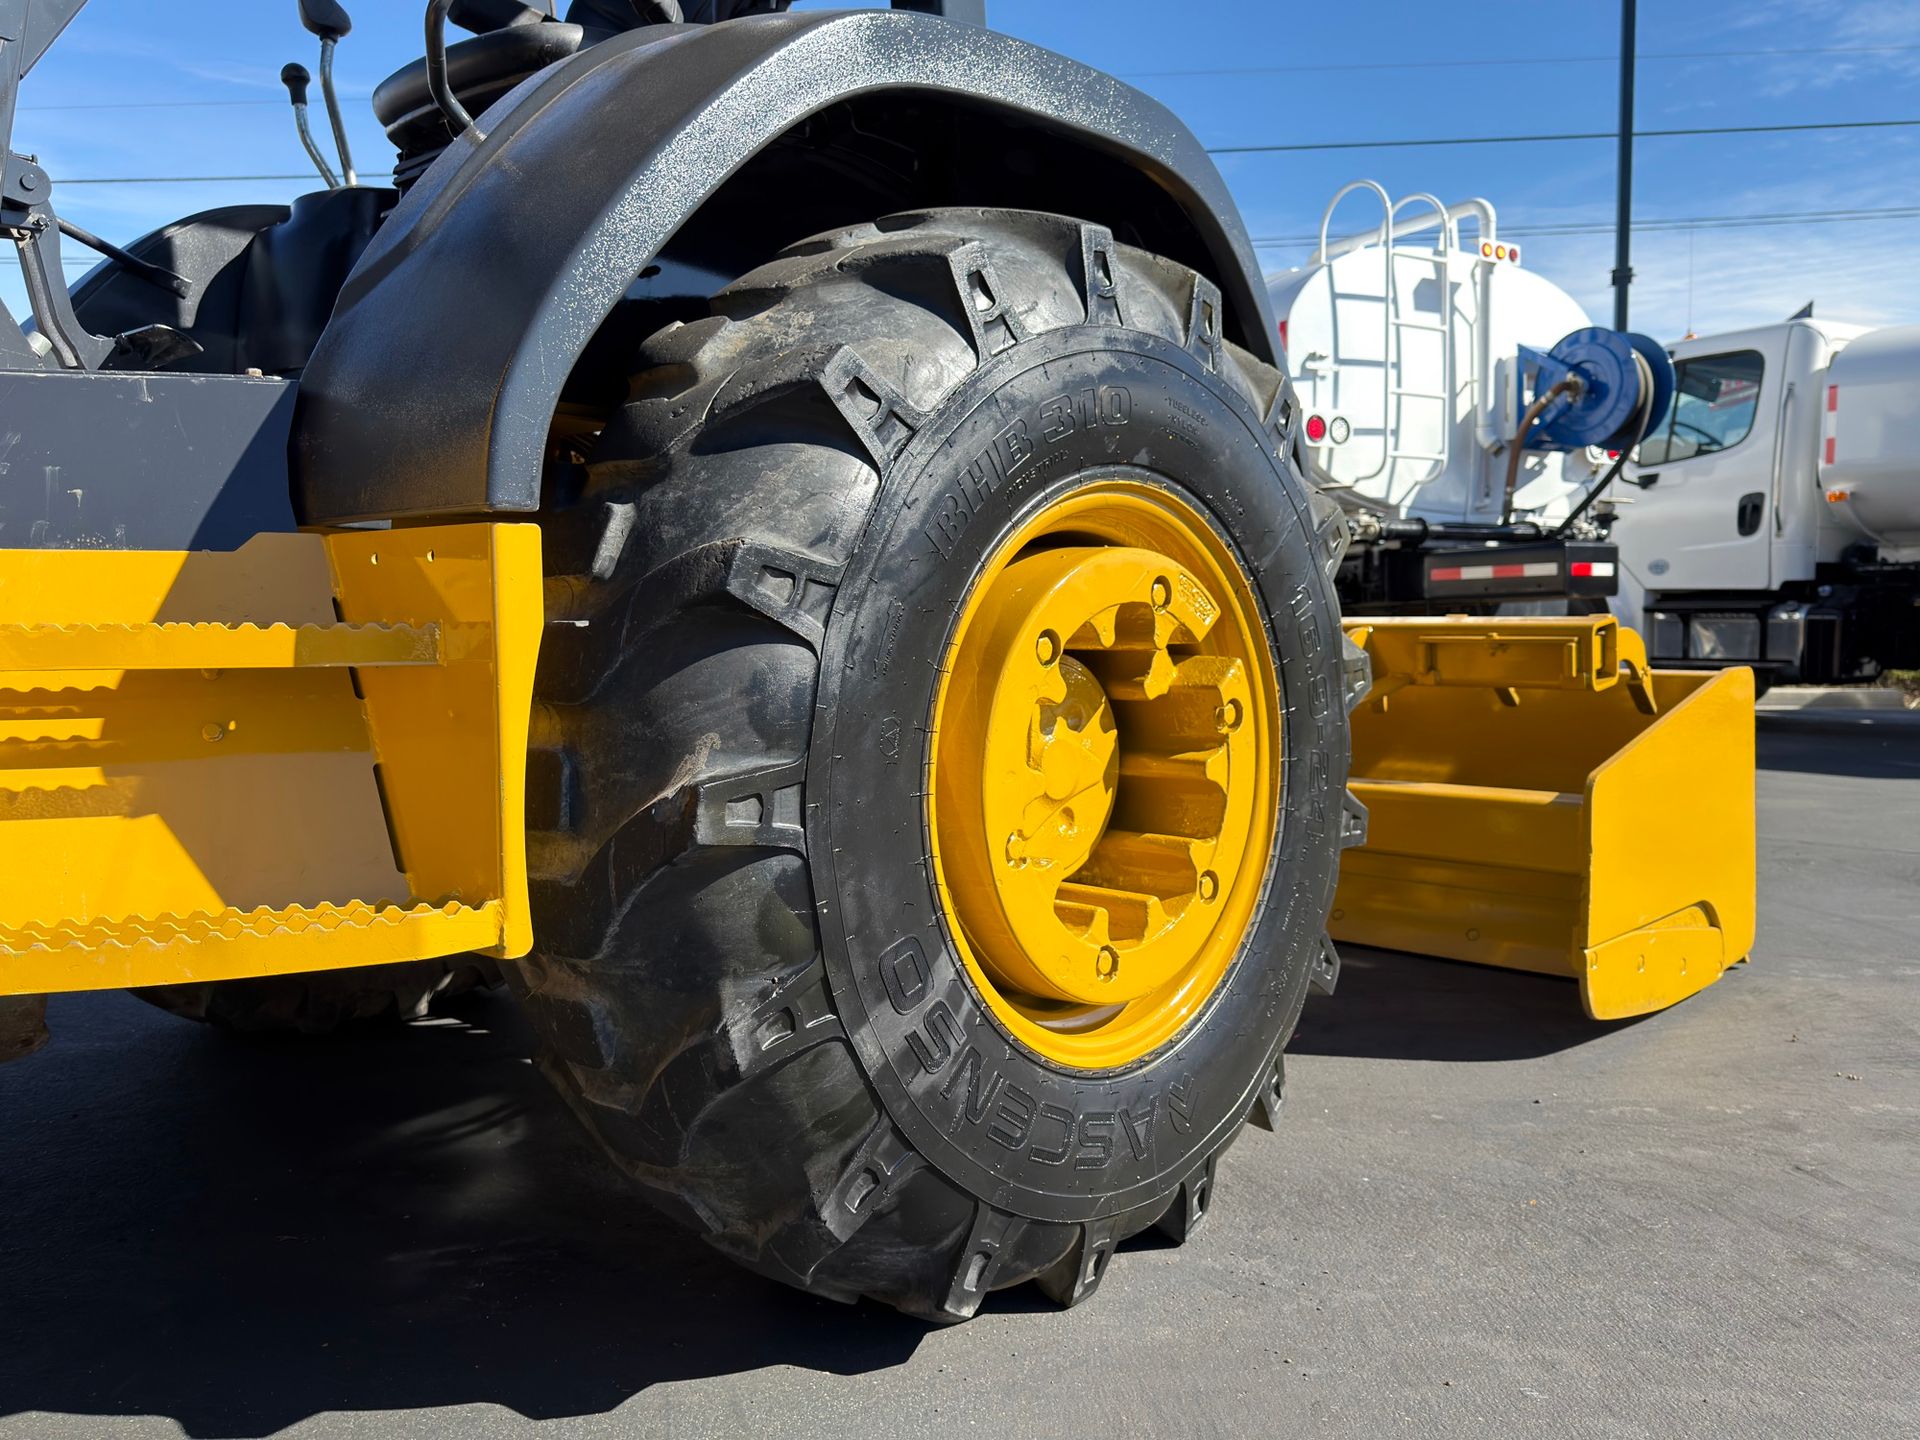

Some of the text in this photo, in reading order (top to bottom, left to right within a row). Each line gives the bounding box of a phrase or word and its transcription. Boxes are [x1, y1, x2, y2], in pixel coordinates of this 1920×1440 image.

[924, 385, 1132, 561] BHB 310
[1289, 583, 1329, 838] 16.9-24
[878, 933, 1161, 1172] ASCENSO
